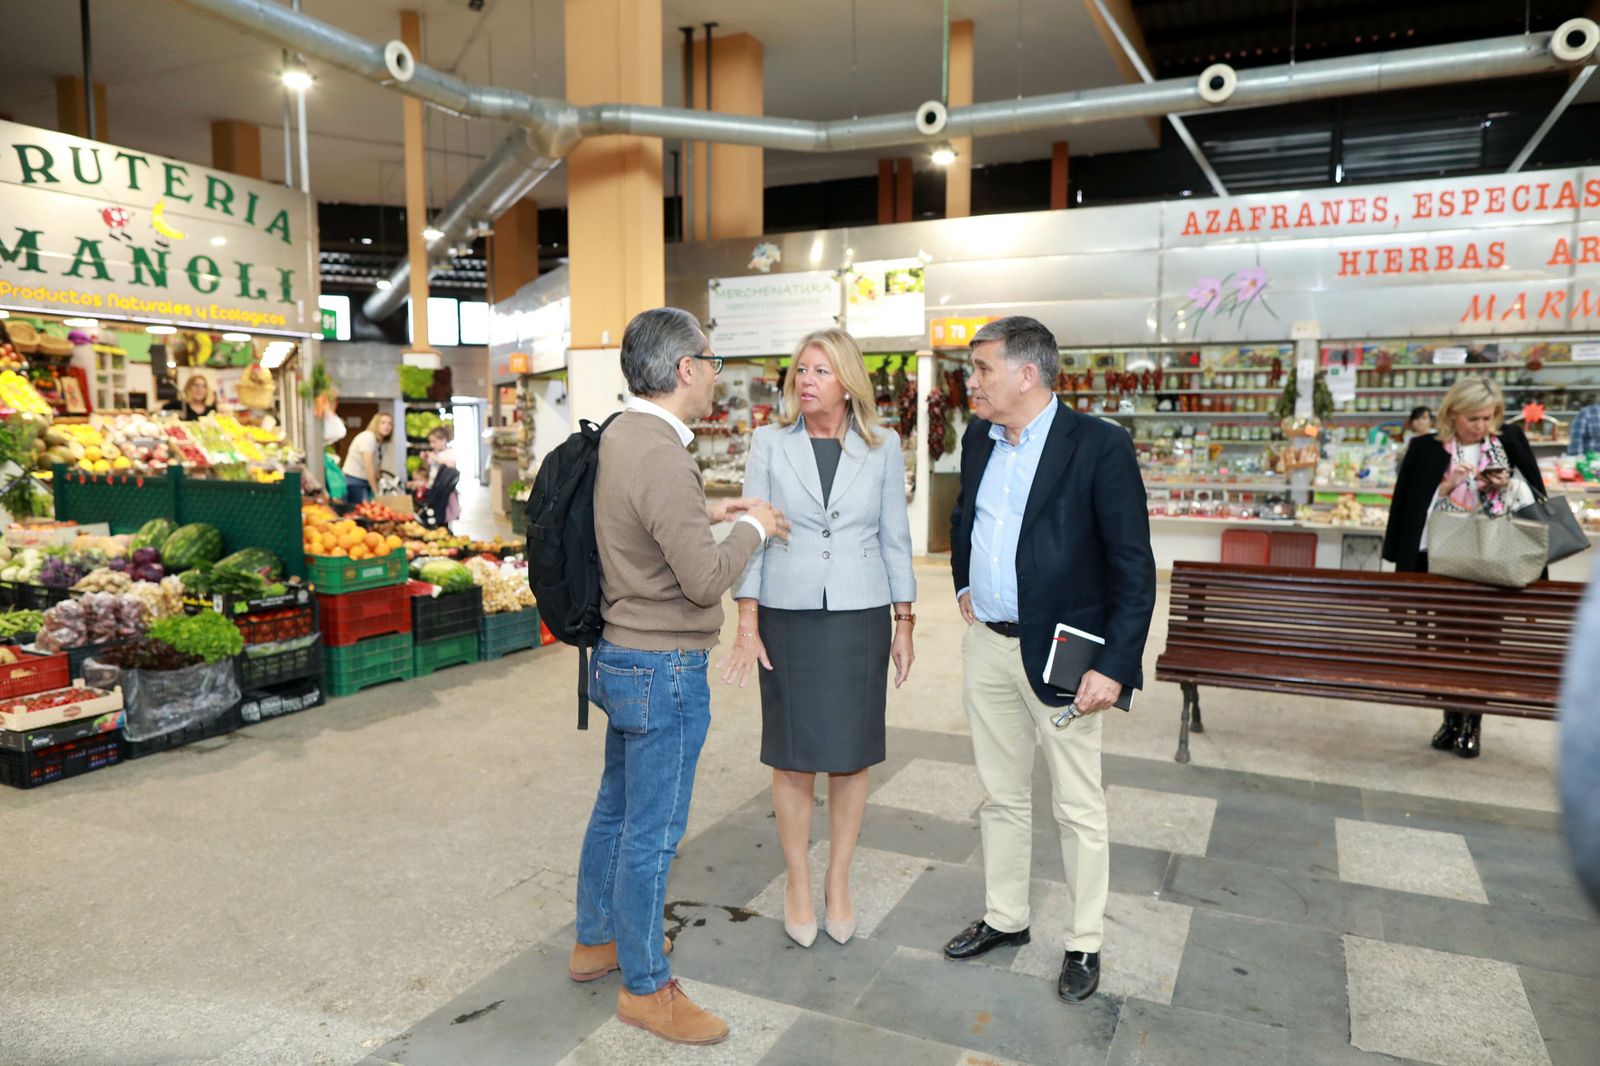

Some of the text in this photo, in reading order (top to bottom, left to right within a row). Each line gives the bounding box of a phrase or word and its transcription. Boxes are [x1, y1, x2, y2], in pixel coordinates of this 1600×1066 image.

[0, 144, 291, 245] RUTERIA
[1181, 179, 1600, 231] AZAFRANES, ESPECIAS
[1337, 241, 1505, 276] HIERBAS
[0, 280, 102, 307] Productos
[107, 292, 193, 318] Naturales
